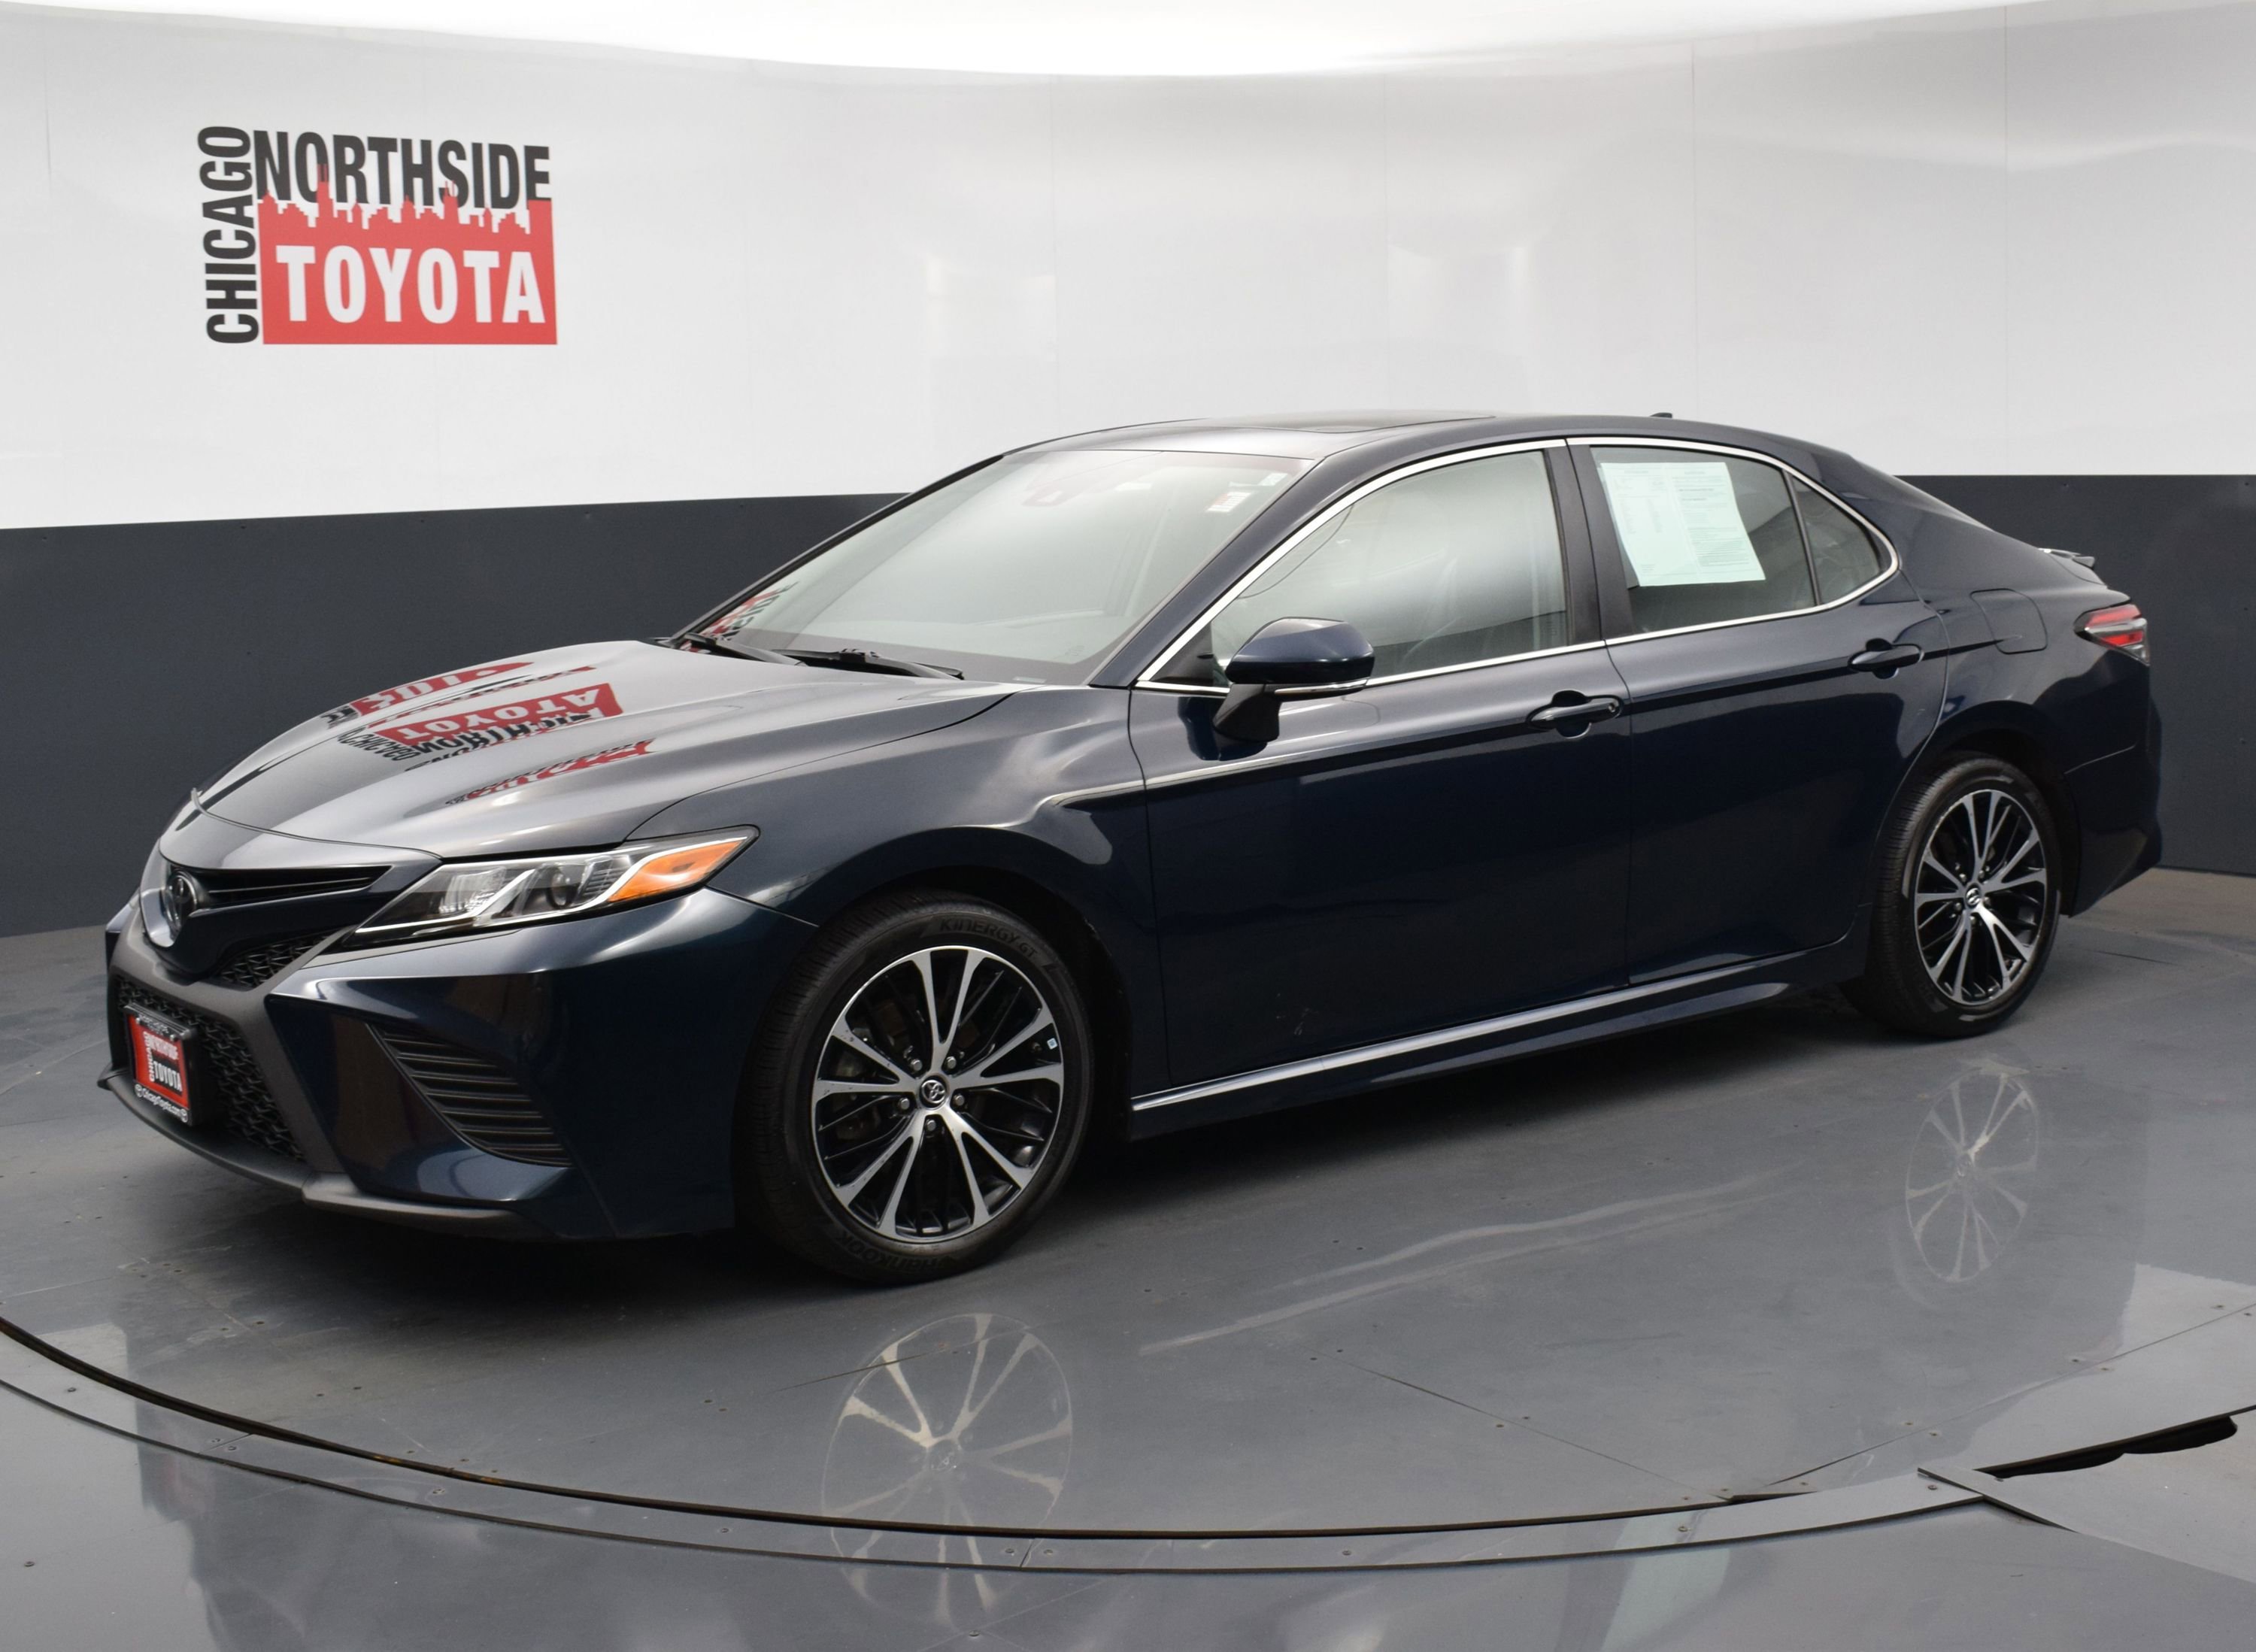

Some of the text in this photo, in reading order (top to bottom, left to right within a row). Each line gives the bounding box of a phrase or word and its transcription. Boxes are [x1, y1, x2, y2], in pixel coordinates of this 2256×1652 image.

[253, 130, 551, 210] NORTHSIDE
[198, 126, 259, 344] CHICAGO
[275, 245, 546, 324] TOYOTA
[153, 1060, 183, 1092] TOYOTA
